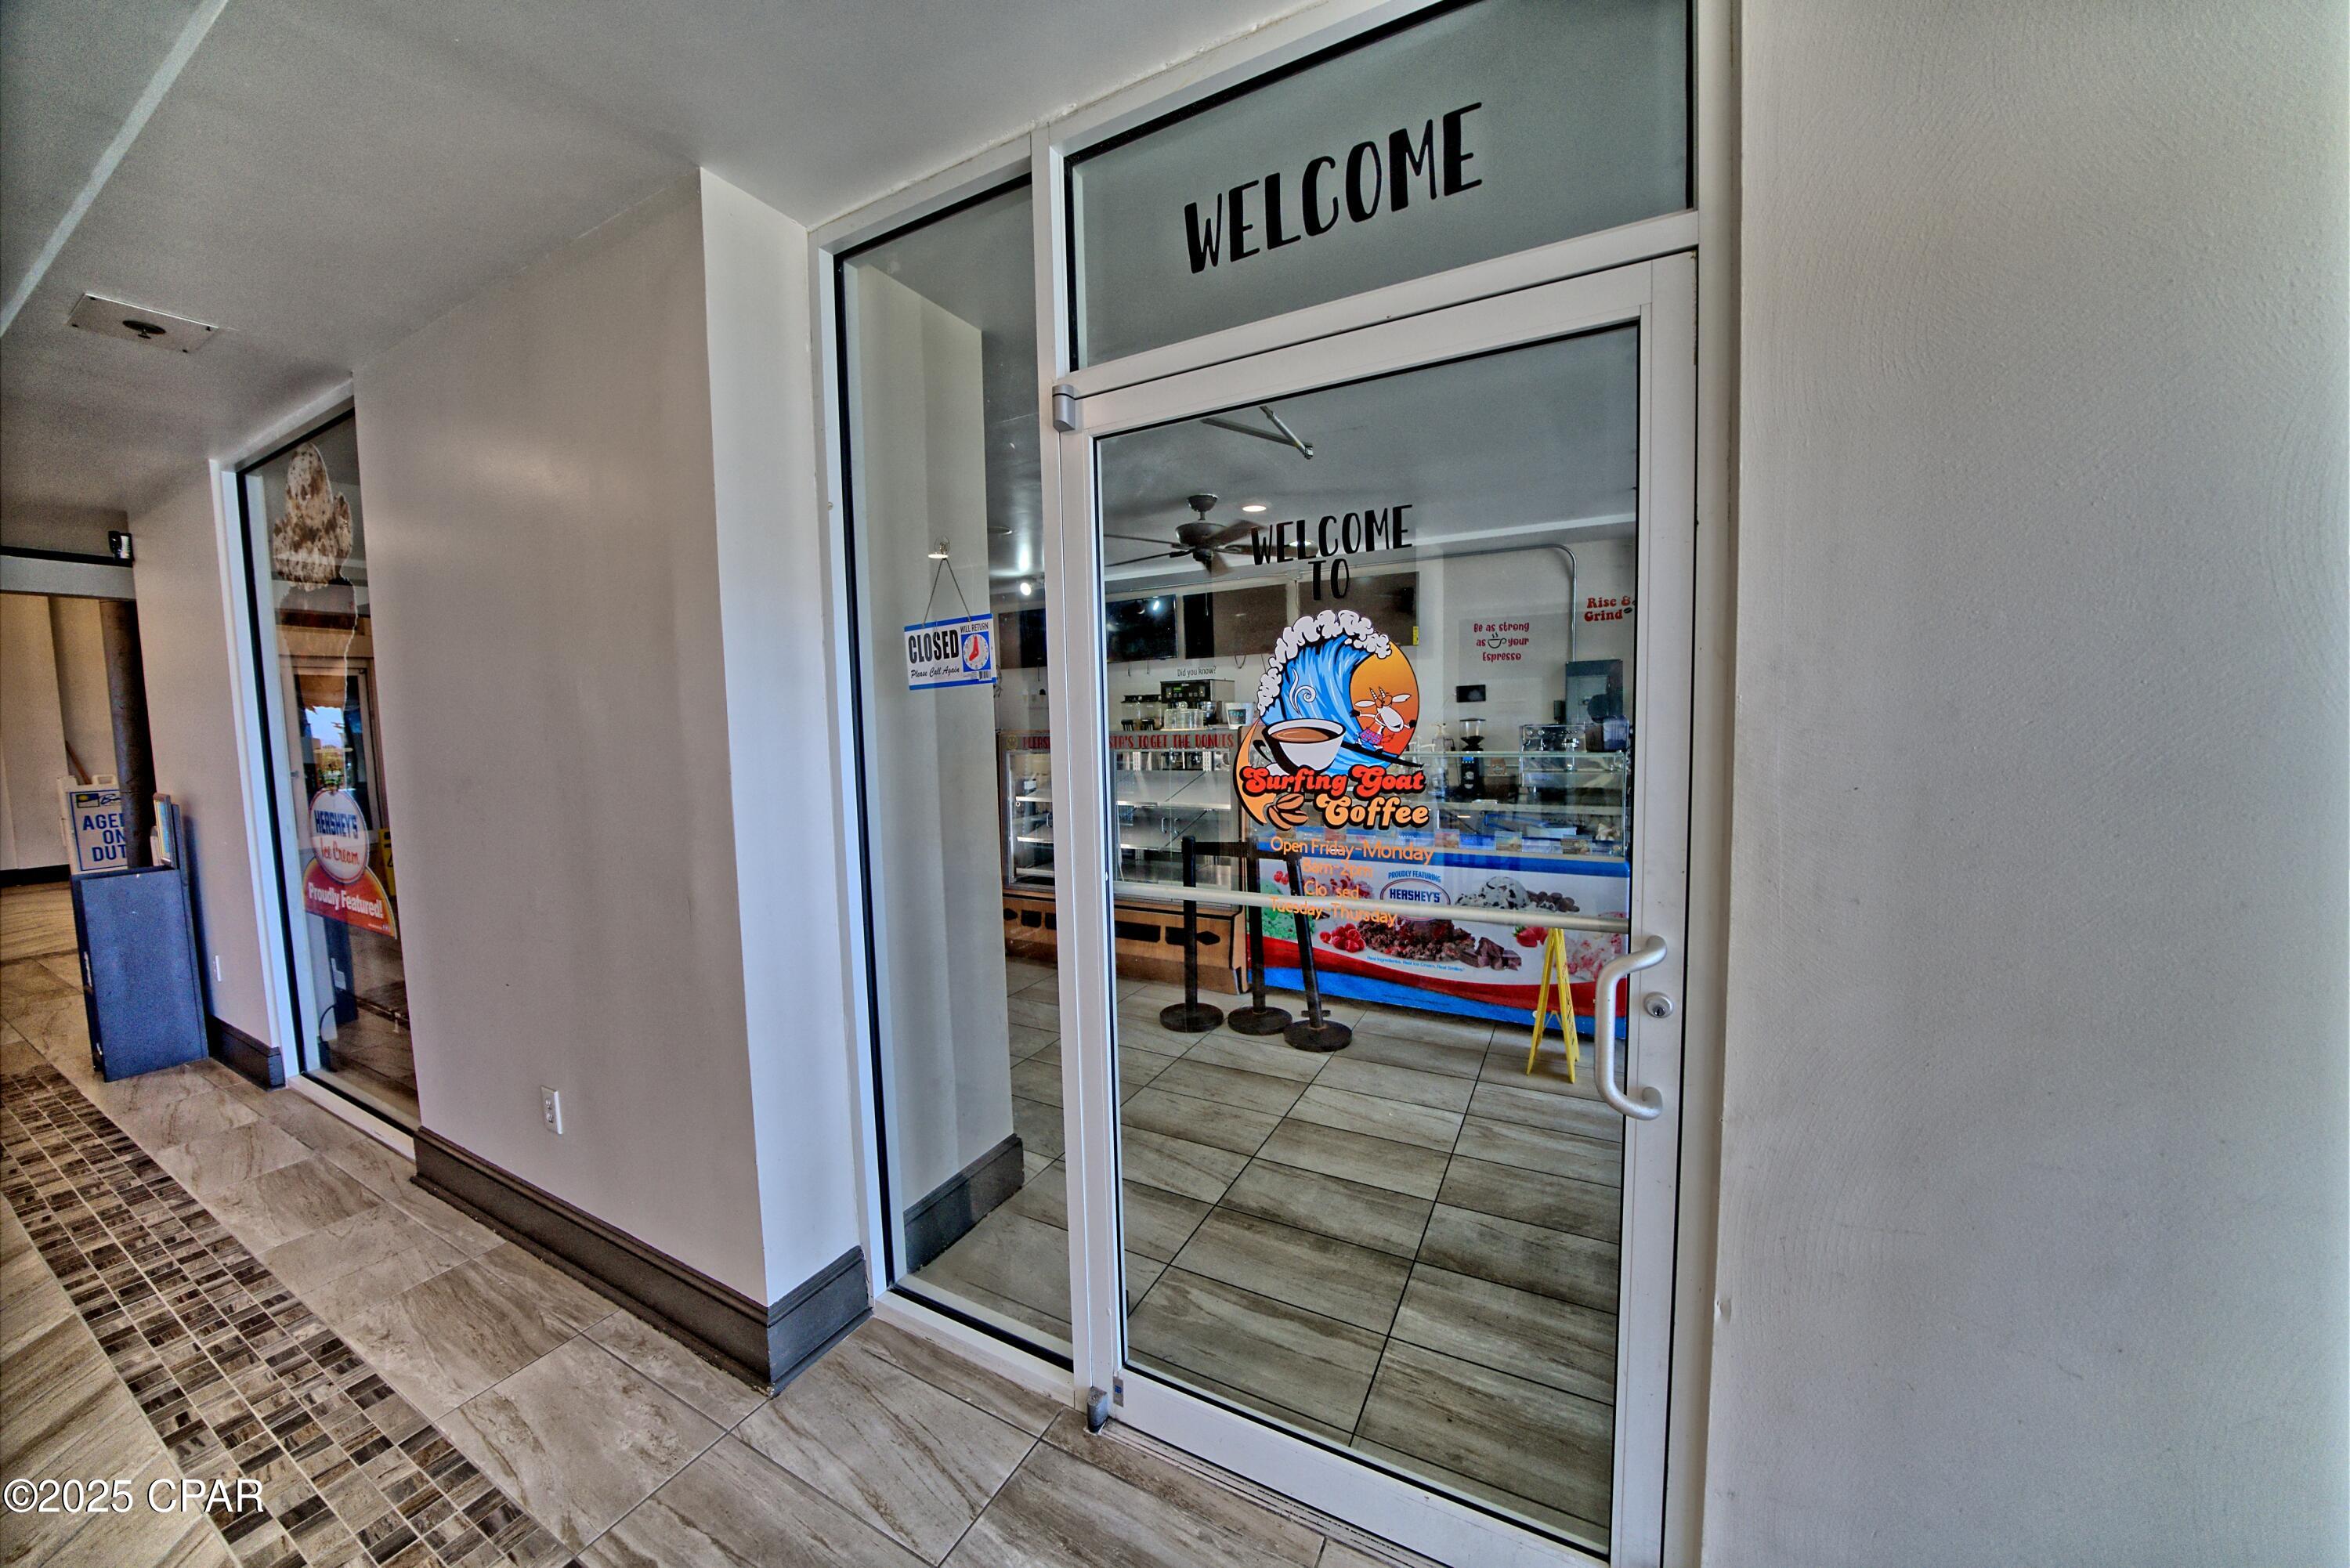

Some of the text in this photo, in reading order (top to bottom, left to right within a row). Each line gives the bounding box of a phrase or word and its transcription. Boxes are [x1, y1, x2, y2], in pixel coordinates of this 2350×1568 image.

[1184, 102, 1482, 273] WELCOME
[1250, 504, 1413, 565] WELCOME
[1307, 558, 1350, 602] TO
[1586, 597, 1617, 609] Rise
[1584, 609, 1623, 622] Grind
[960, 622, 989, 634] WILL RETURN
[1473, 622, 1530, 633] Be as strong
[908, 629, 960, 664] CLOSED
[1476, 637, 1530, 647] as your
[1482, 652, 1522, 663] Espresso
[910, 669, 927, 678] Please
[929, 667, 942, 677] Call
[942, 665, 960, 675] Again
[1177, 666, 1217, 677] Did you know?
[1150, 734, 1167, 748] GET
[1173, 734, 1191, 748] THE
[1195, 733, 1235, 748] DONUTS
[1241, 764, 1425, 797] Surfing Goat
[1315, 793, 1430, 827] Coffee
[314, 809, 359, 840] HERSHEY'S
[320, 837, 360, 865] Ice Cream
[1270, 836, 1308, 855] Open
[1388, 870, 1441, 883] PROUDLY FEATURING
[308, 882, 384, 919] Proudly Featured!
[1389, 887, 1441, 903] HERSHEY'S
